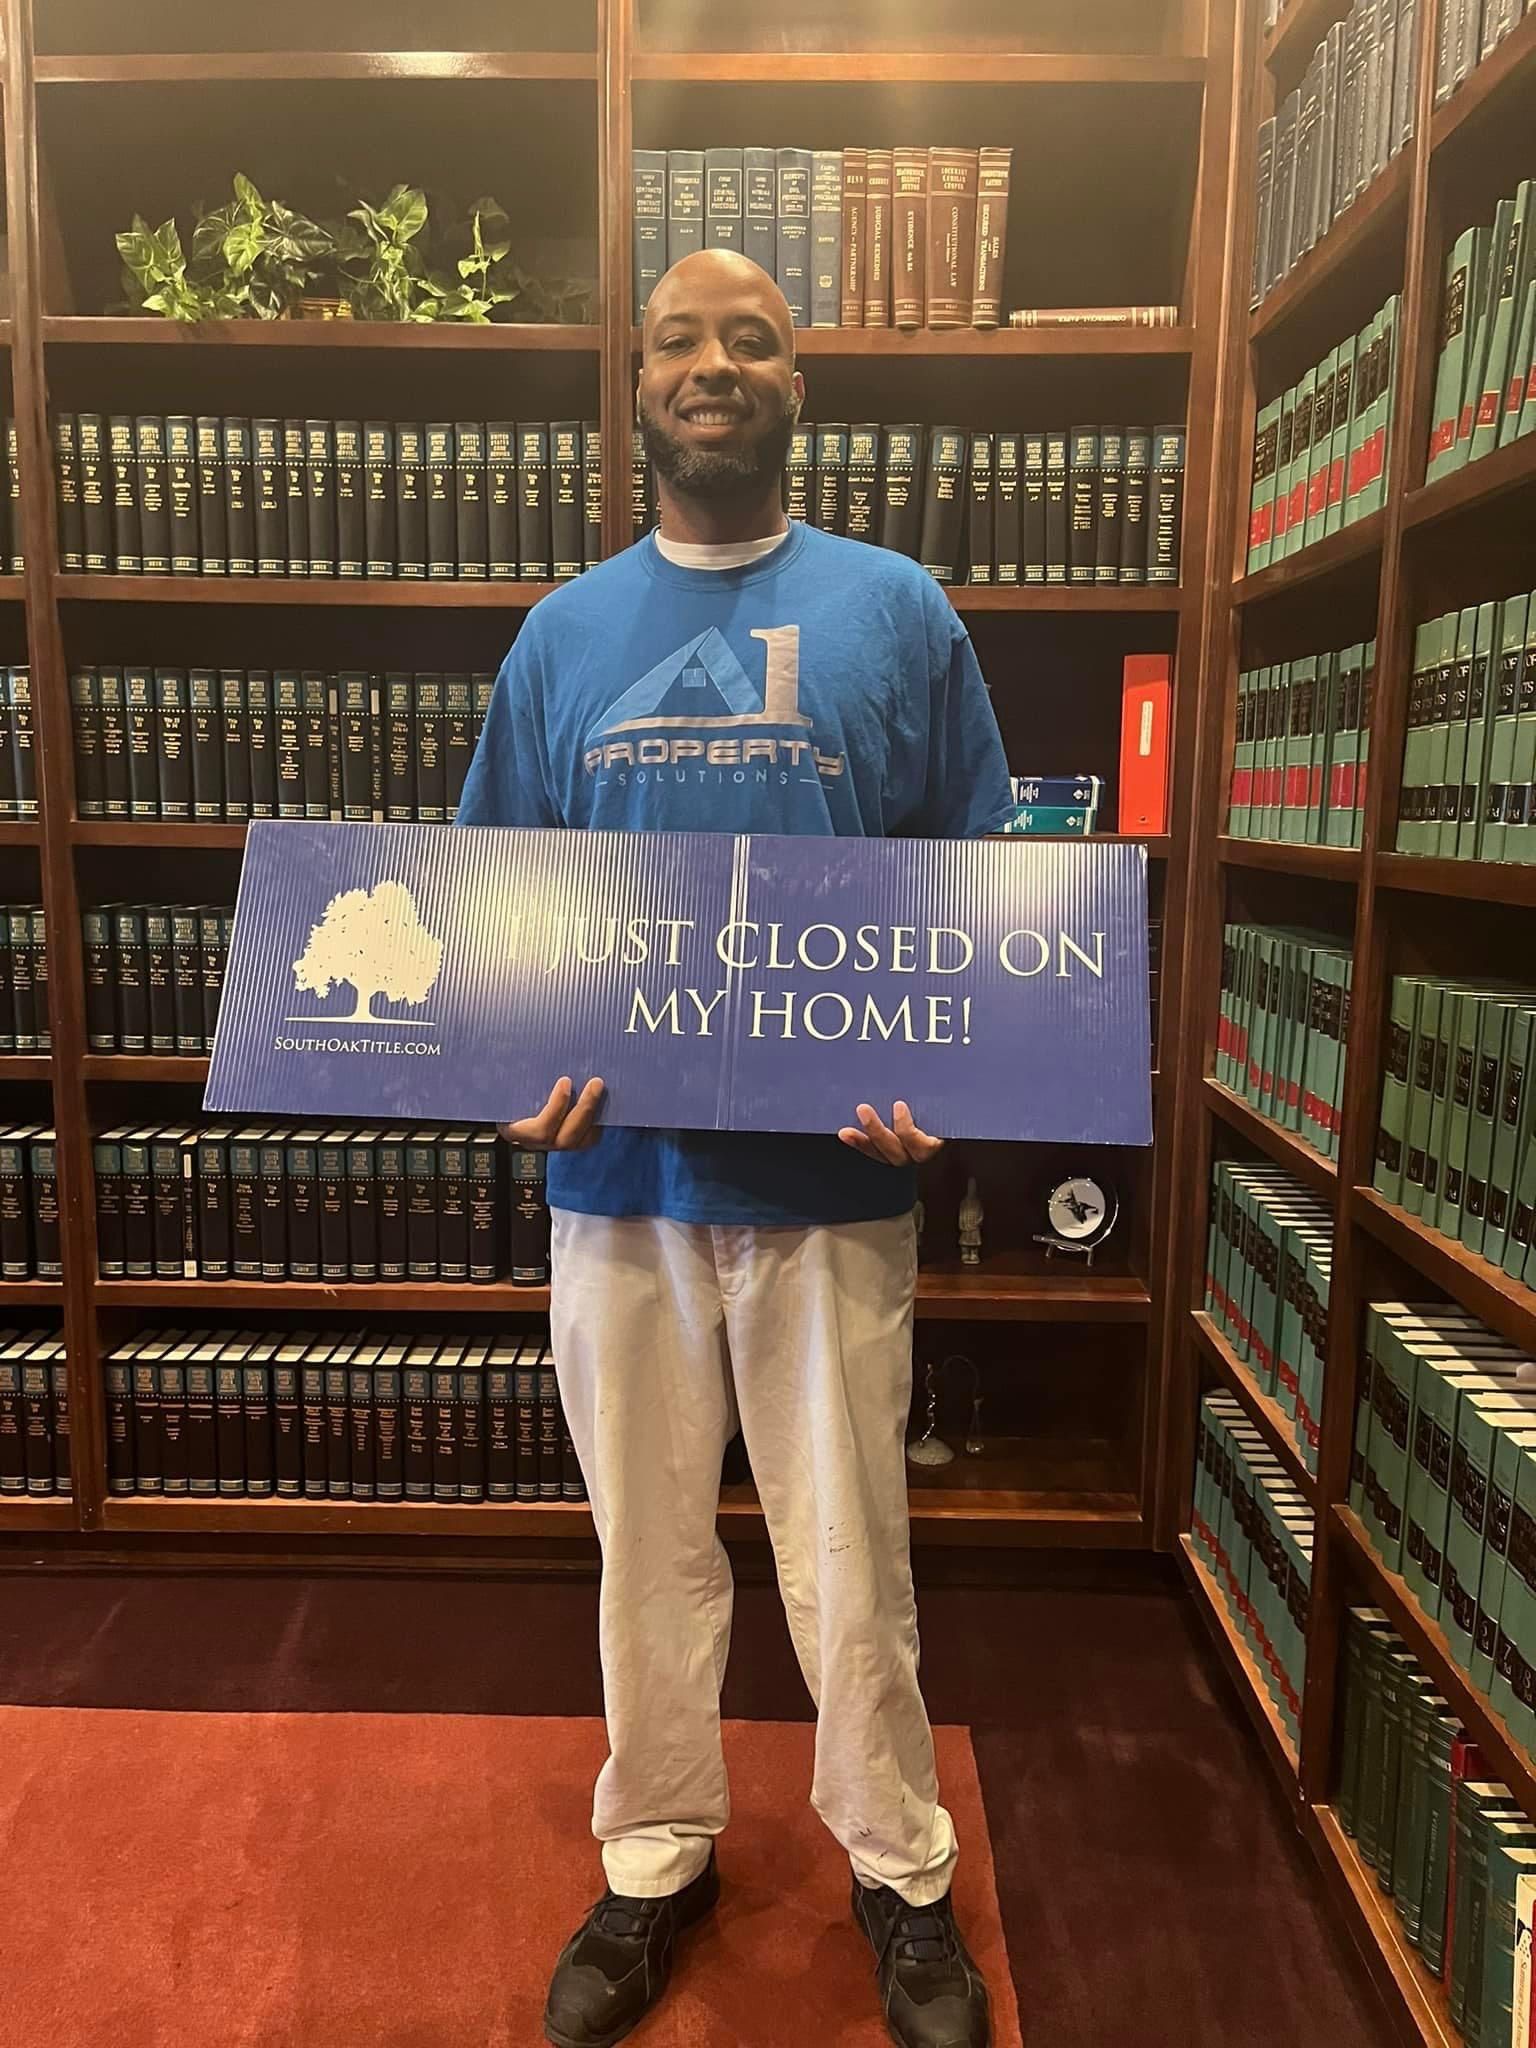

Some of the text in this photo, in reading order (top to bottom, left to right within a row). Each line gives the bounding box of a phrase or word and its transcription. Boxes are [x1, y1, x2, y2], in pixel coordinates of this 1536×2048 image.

[584, 739, 846, 776] PROPERTY
[618, 769, 788, 786] SOLUTIONS
[543, 917, 695, 975] JUST
[716, 922, 974, 974] CLOSED
[999, 929, 1107, 979] ON
[624, 987, 971, 1045] MY HOME!
